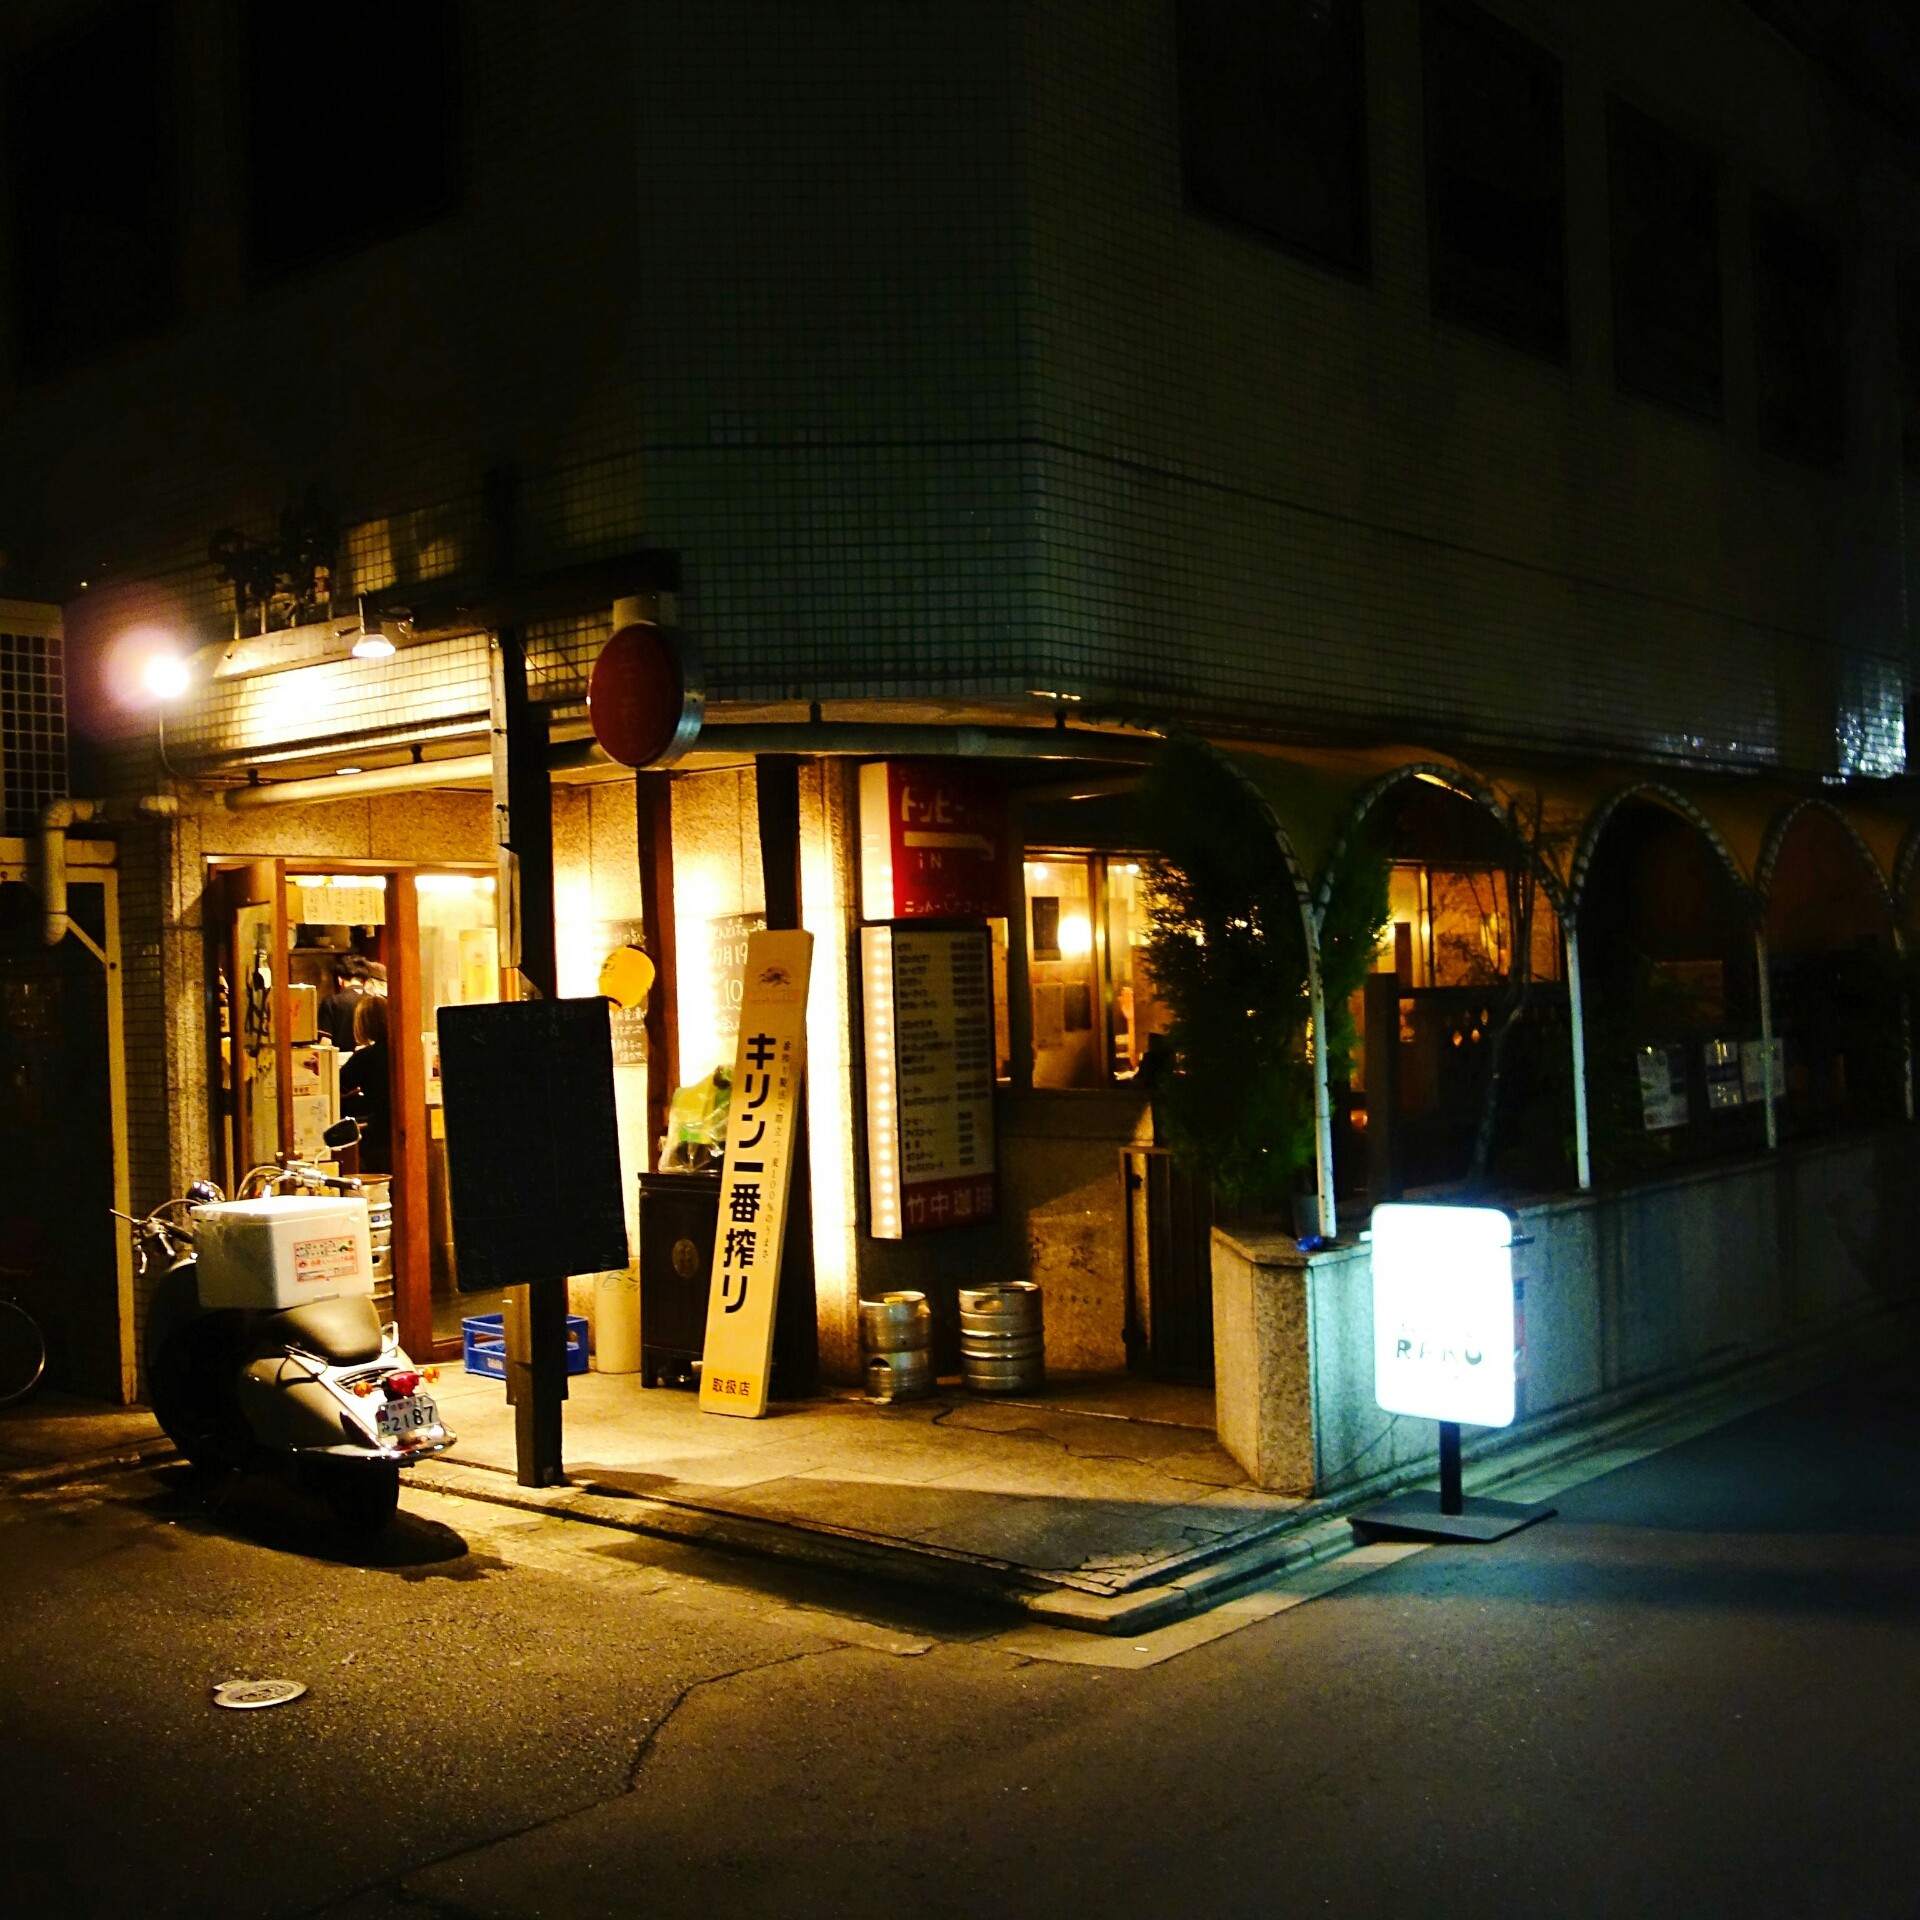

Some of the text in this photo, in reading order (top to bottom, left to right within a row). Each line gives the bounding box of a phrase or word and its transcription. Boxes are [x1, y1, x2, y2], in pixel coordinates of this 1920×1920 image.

[722, 1033, 777, 1314] キリン一番搾り
[711, 1377, 751, 1397] 取扱店
[391, 1406, 434, 1432] 2187
